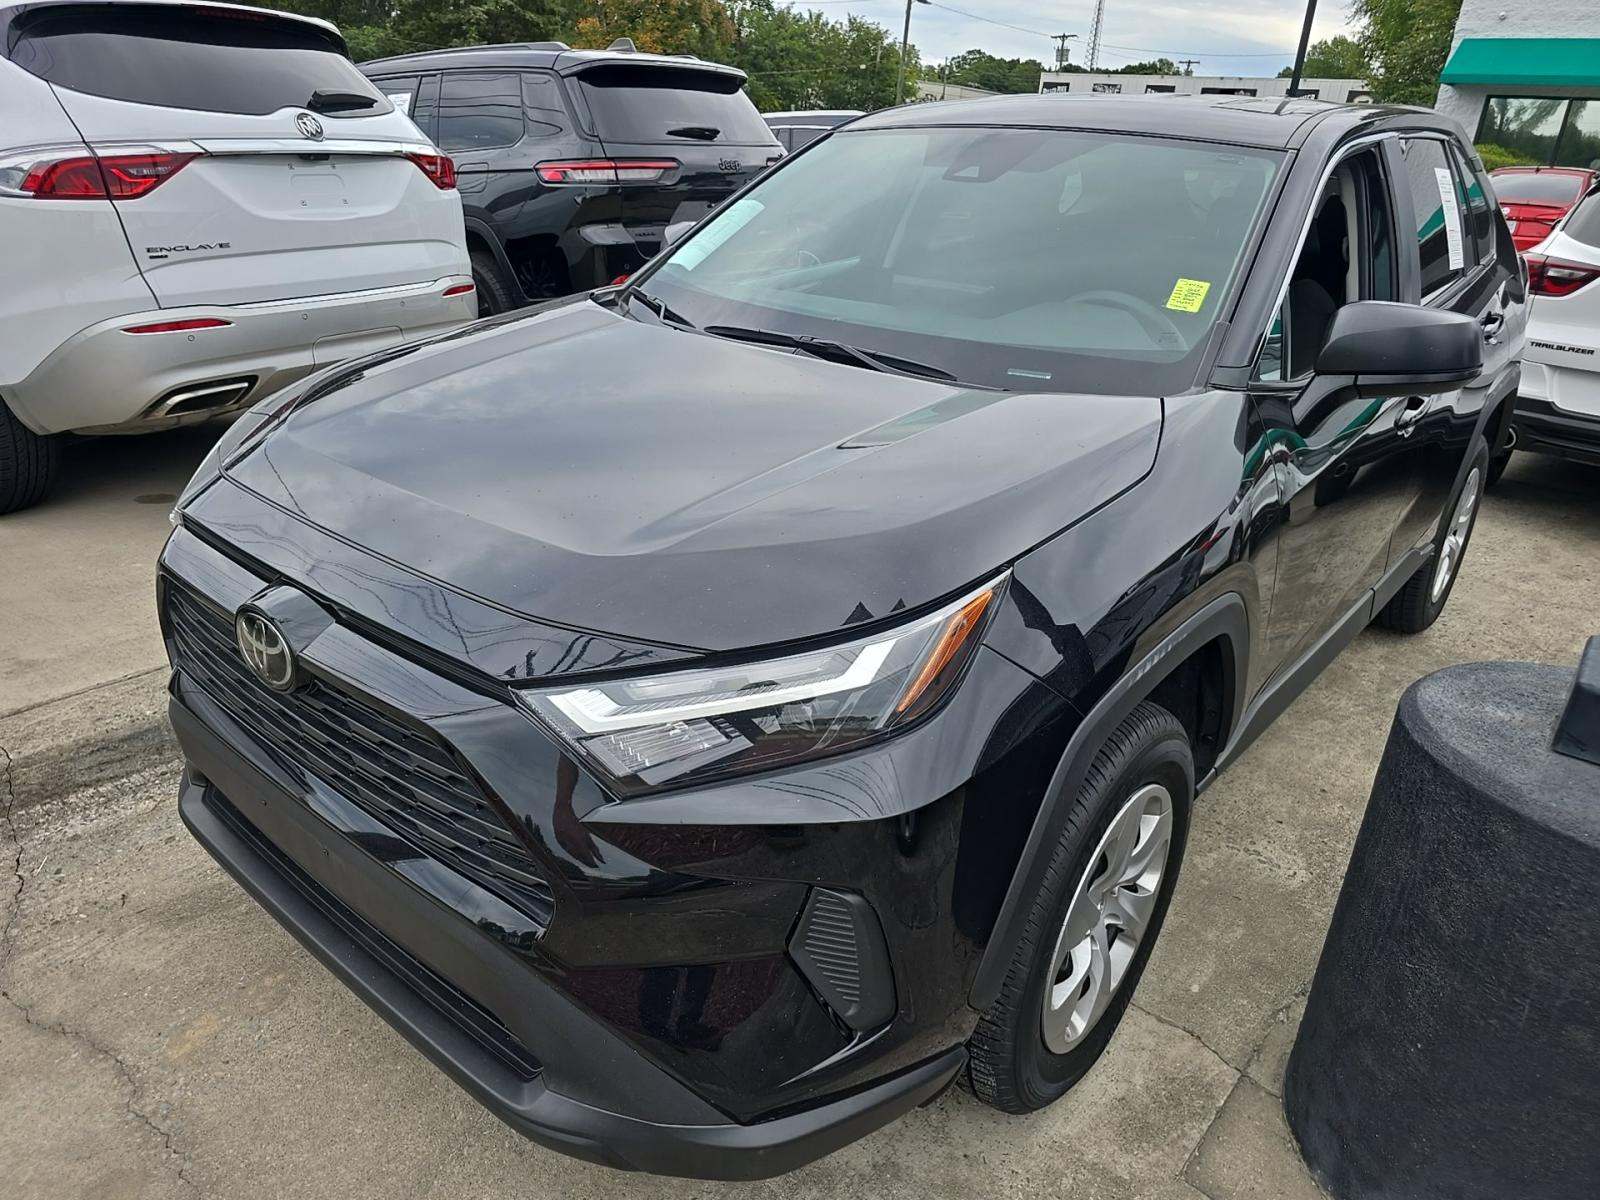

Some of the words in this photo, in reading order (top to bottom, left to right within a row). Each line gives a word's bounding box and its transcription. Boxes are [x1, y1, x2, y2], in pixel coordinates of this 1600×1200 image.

[718, 158, 742, 172] Jeep
[145, 242, 231, 253] ENCLAVE
[1530, 341, 1595, 355] TRAILBLAZER
